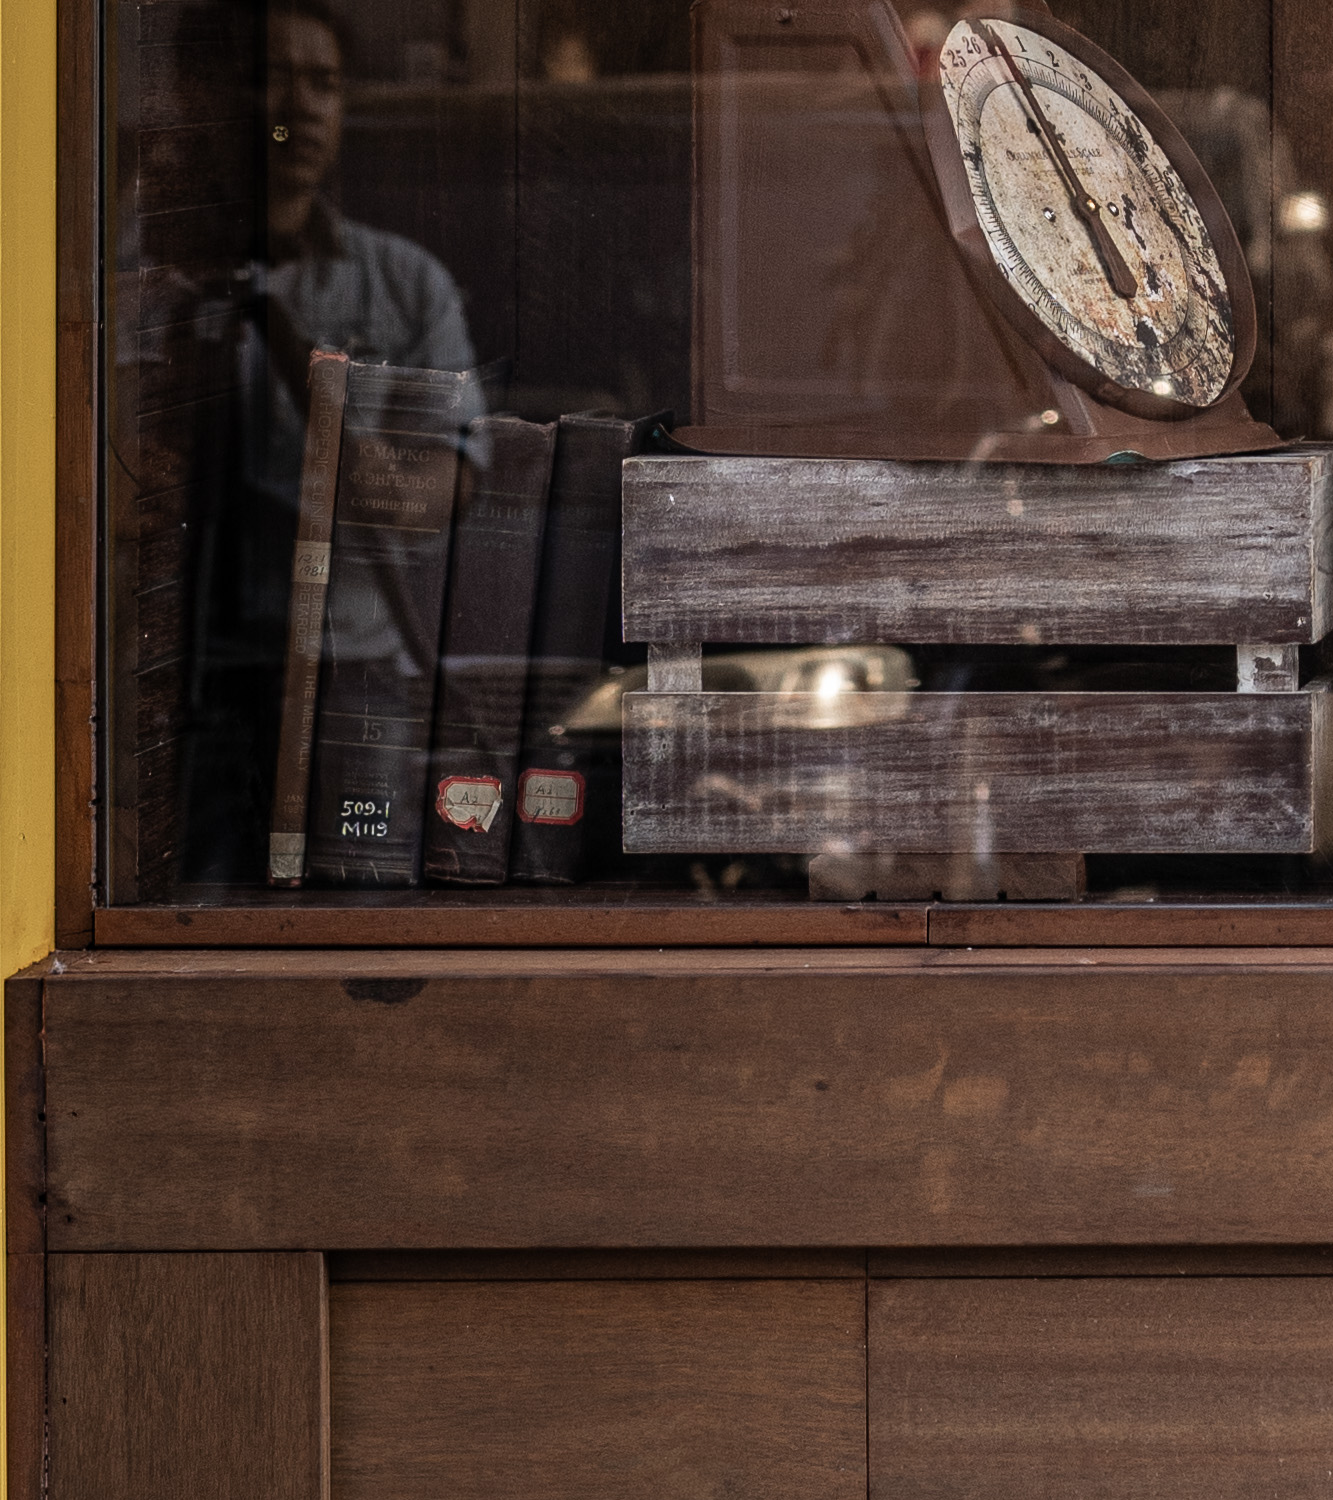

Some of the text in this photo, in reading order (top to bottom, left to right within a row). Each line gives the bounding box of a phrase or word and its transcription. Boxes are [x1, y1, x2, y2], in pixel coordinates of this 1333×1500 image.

[961, 35, 982, 55] 26
[1014, 35, 1028, 53] 1
[947, 49, 967, 68] 25
[1046, 49, 1061, 68] 2
[314, 366, 336, 477] ORTHOPEDIC
[298, 565, 325, 577] 1981
[295, 584, 311, 655] RETARDED
[297, 584, 324, 772] SURGERY IN THE MENTALLY
[362, 720, 383, 742] 15
[340, 801, 391, 819] 509.1
[341, 821, 389, 838] M119
